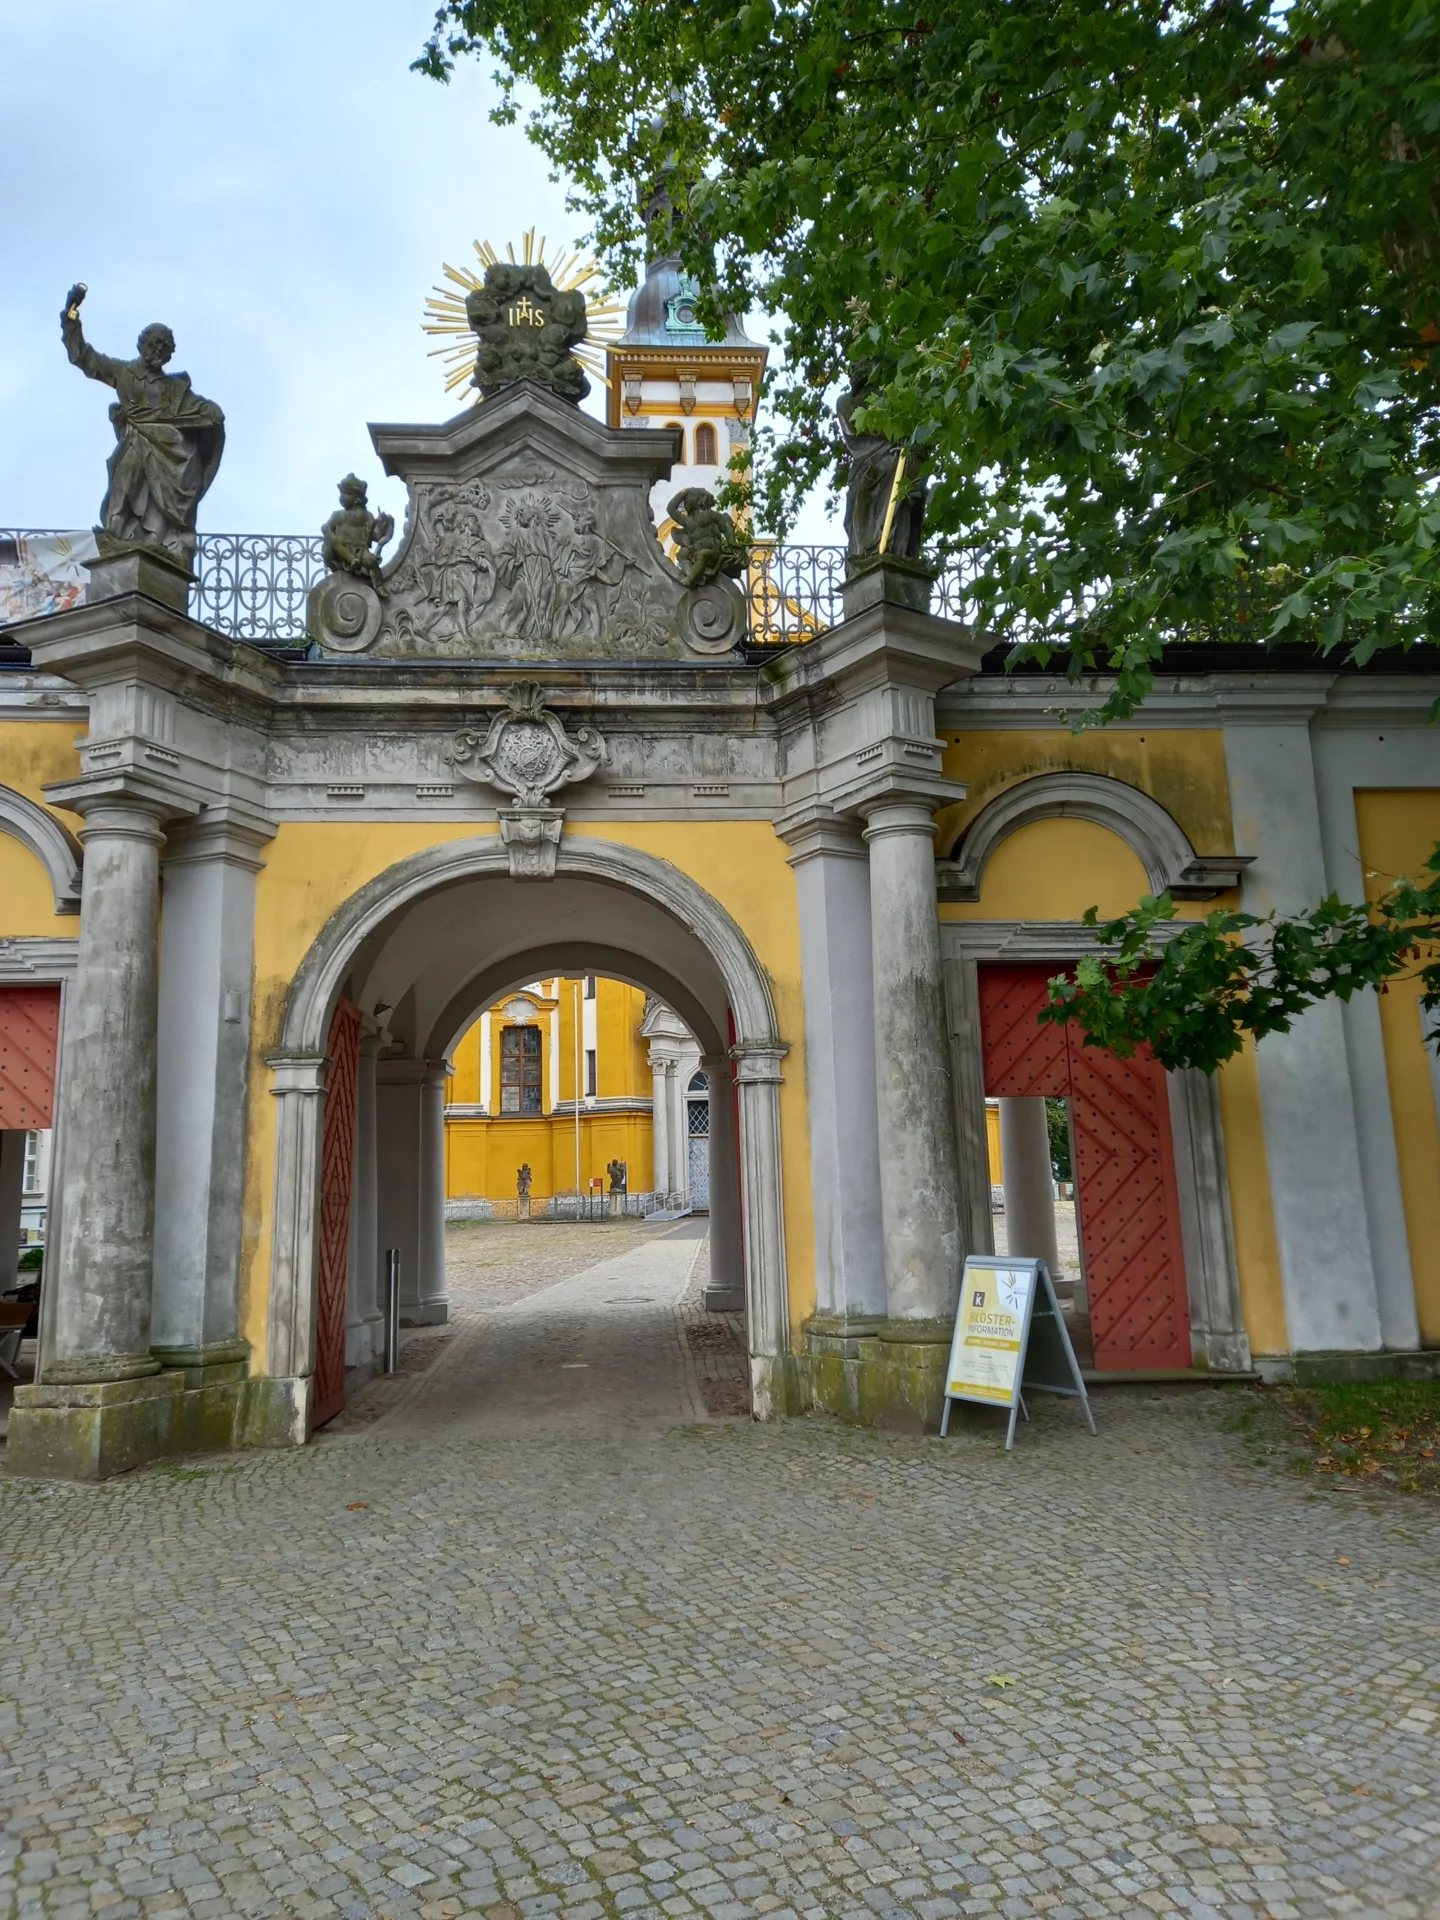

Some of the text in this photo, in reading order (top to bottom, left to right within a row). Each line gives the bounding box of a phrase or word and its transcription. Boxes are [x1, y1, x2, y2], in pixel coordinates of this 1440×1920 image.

[509, 297, 545, 327] IHS
[969, 1312, 1016, 1327] KLOSTER-
[968, 1324, 1015, 1338] INFORMATION
